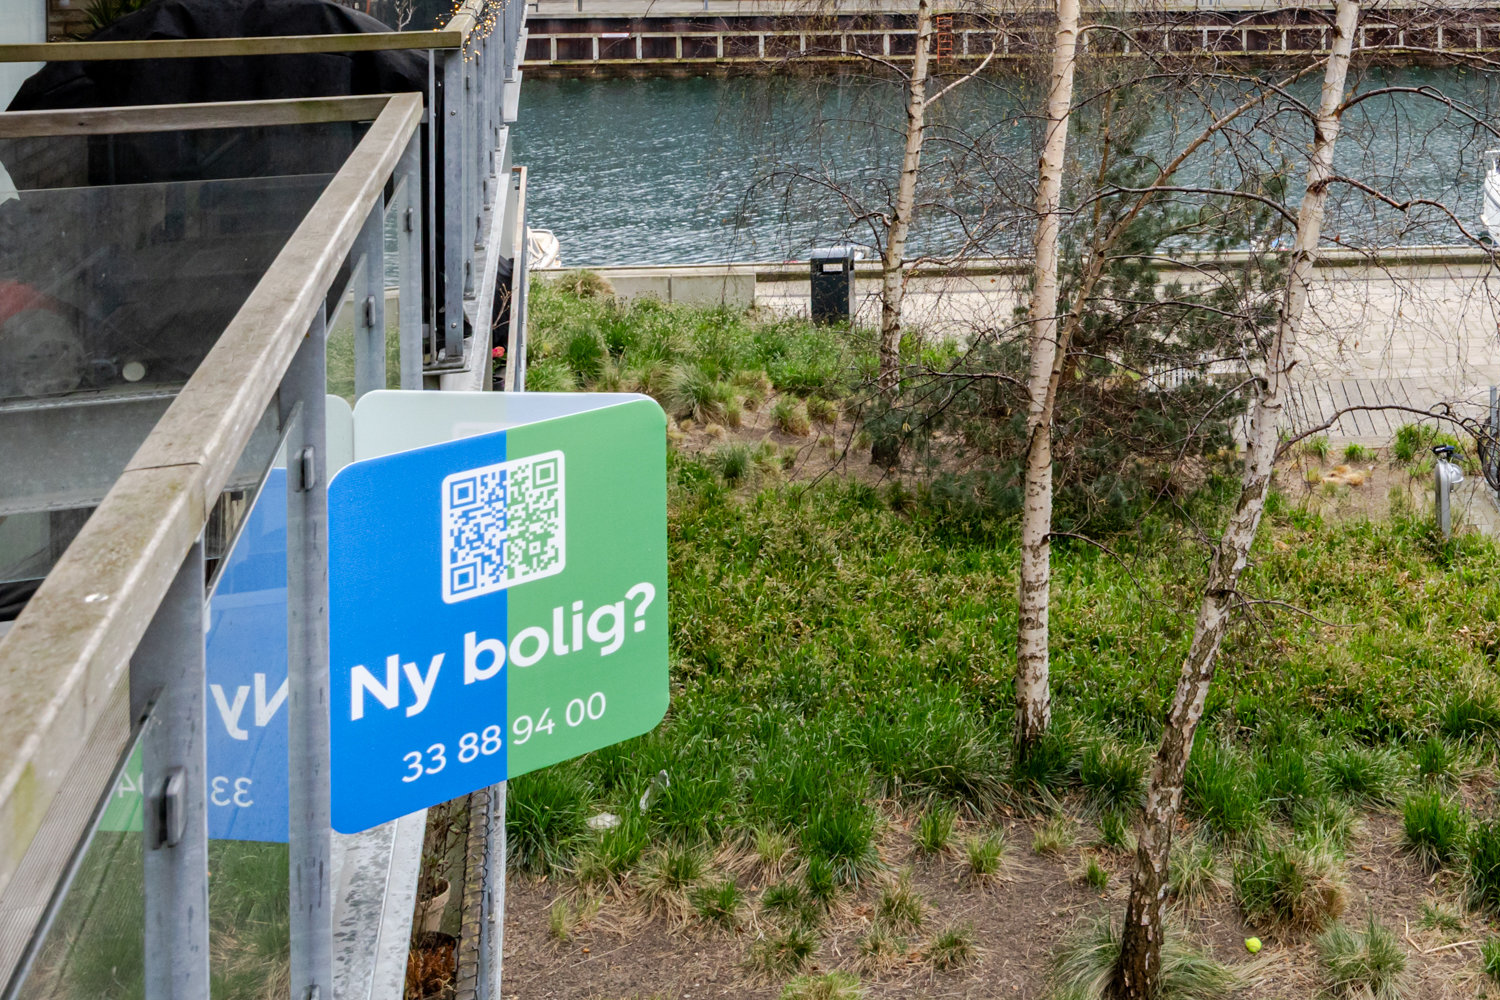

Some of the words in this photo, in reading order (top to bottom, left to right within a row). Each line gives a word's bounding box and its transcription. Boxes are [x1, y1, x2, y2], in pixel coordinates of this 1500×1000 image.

[351, 652, 446, 721] Ny
[464, 582, 656, 685] bolig?
[402, 742, 447, 783] 33
[458, 725, 502, 763] 88
[512, 707, 556, 745] 94
[565, 691, 607, 728] 00
